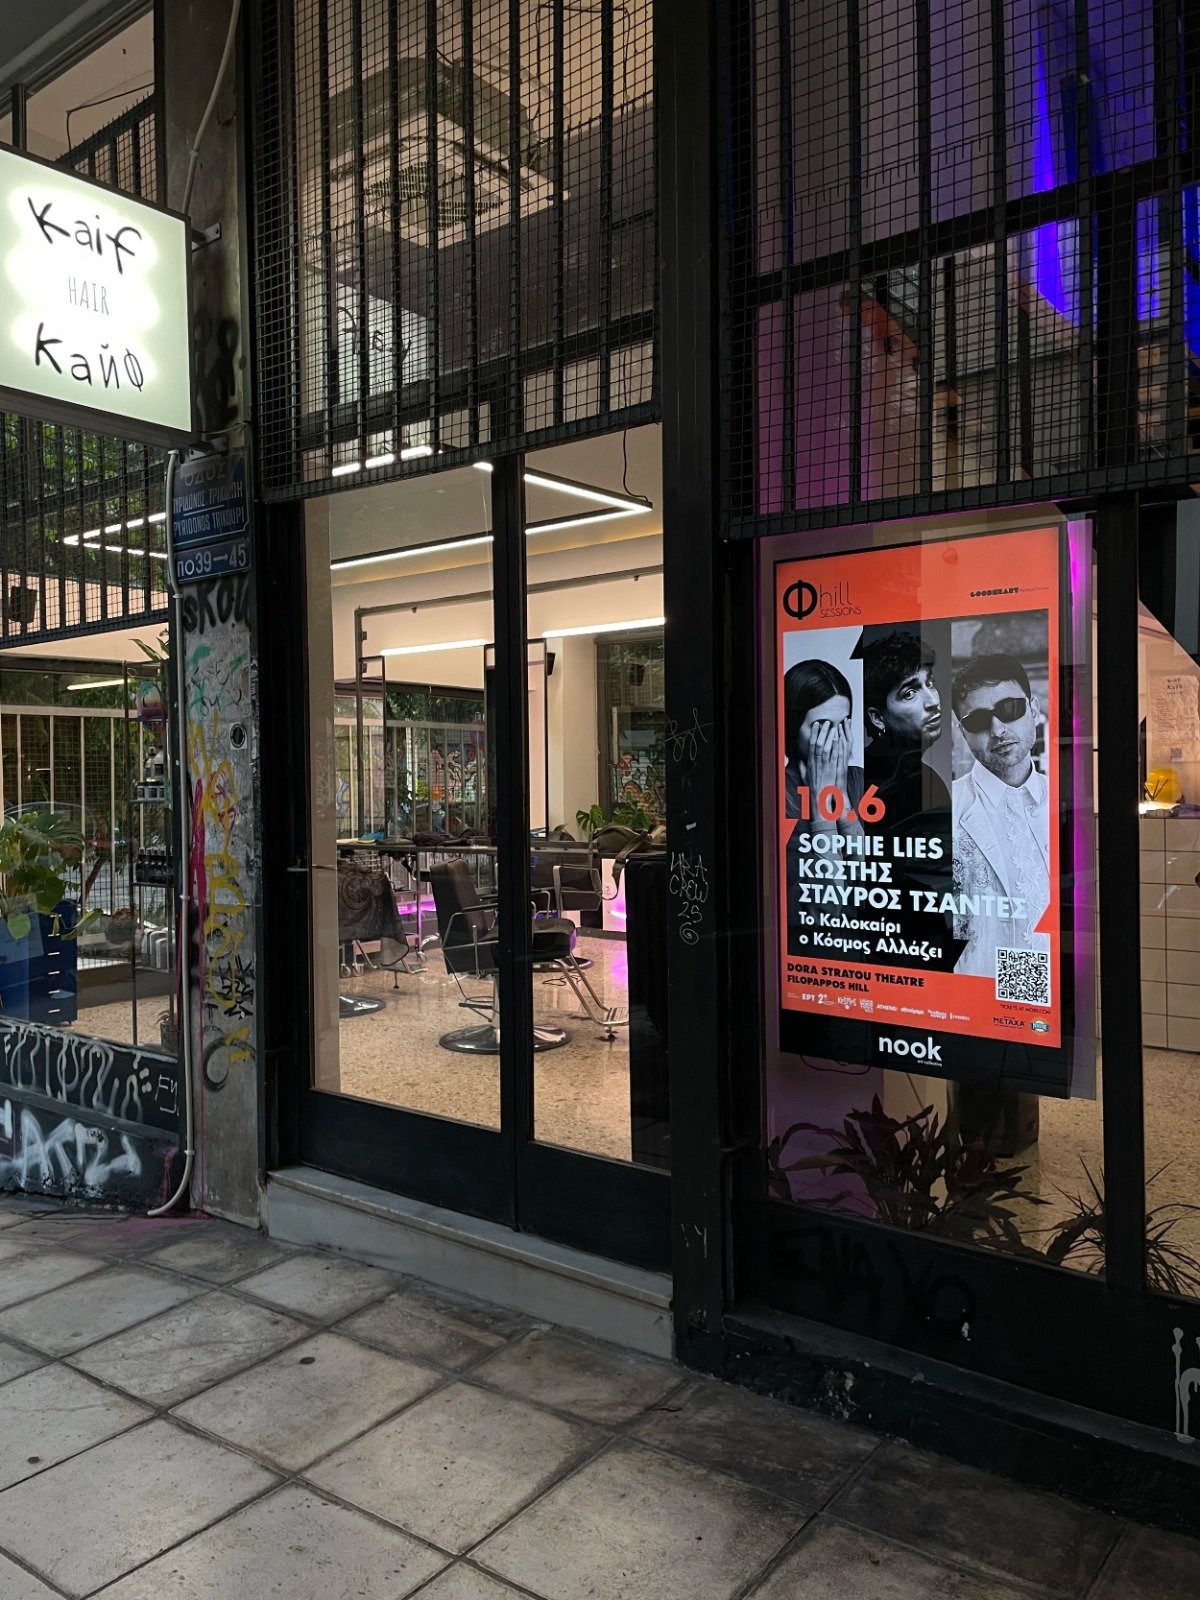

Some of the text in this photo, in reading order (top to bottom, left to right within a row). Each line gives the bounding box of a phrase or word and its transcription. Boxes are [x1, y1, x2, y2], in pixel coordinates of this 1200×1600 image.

[27, 196, 142, 275] Kaif
[67, 276, 110, 316] HAIR
[173, 514, 211, 538] PYRIDONOS
[229, 543, 246, 568] 45
[820, 606, 862, 619] SESSIONS
[797, 783, 886, 823] 10.6
[798, 832, 944, 860] SOPHIE LIES
[798, 858, 893, 883] ΚΩΣΤΗΣ
[798, 883, 1027, 919] ΣΤΑΥΡΟΣ ΤΣΑΝΤΕΣ
[798, 911, 901, 936] Το Καλοκαίρι
[799, 932, 943, 961] ο Κόσμος Αλλάζει
[787, 962, 925, 988] DORA STRATOU THEATRE
[787, 974, 869, 993] FILOPAPPOS HILL
[1000, 1003, 1018, 1011] TICKETS
[993, 1016, 1025, 1027] METAXA
[878, 1037, 942, 1062] nook
